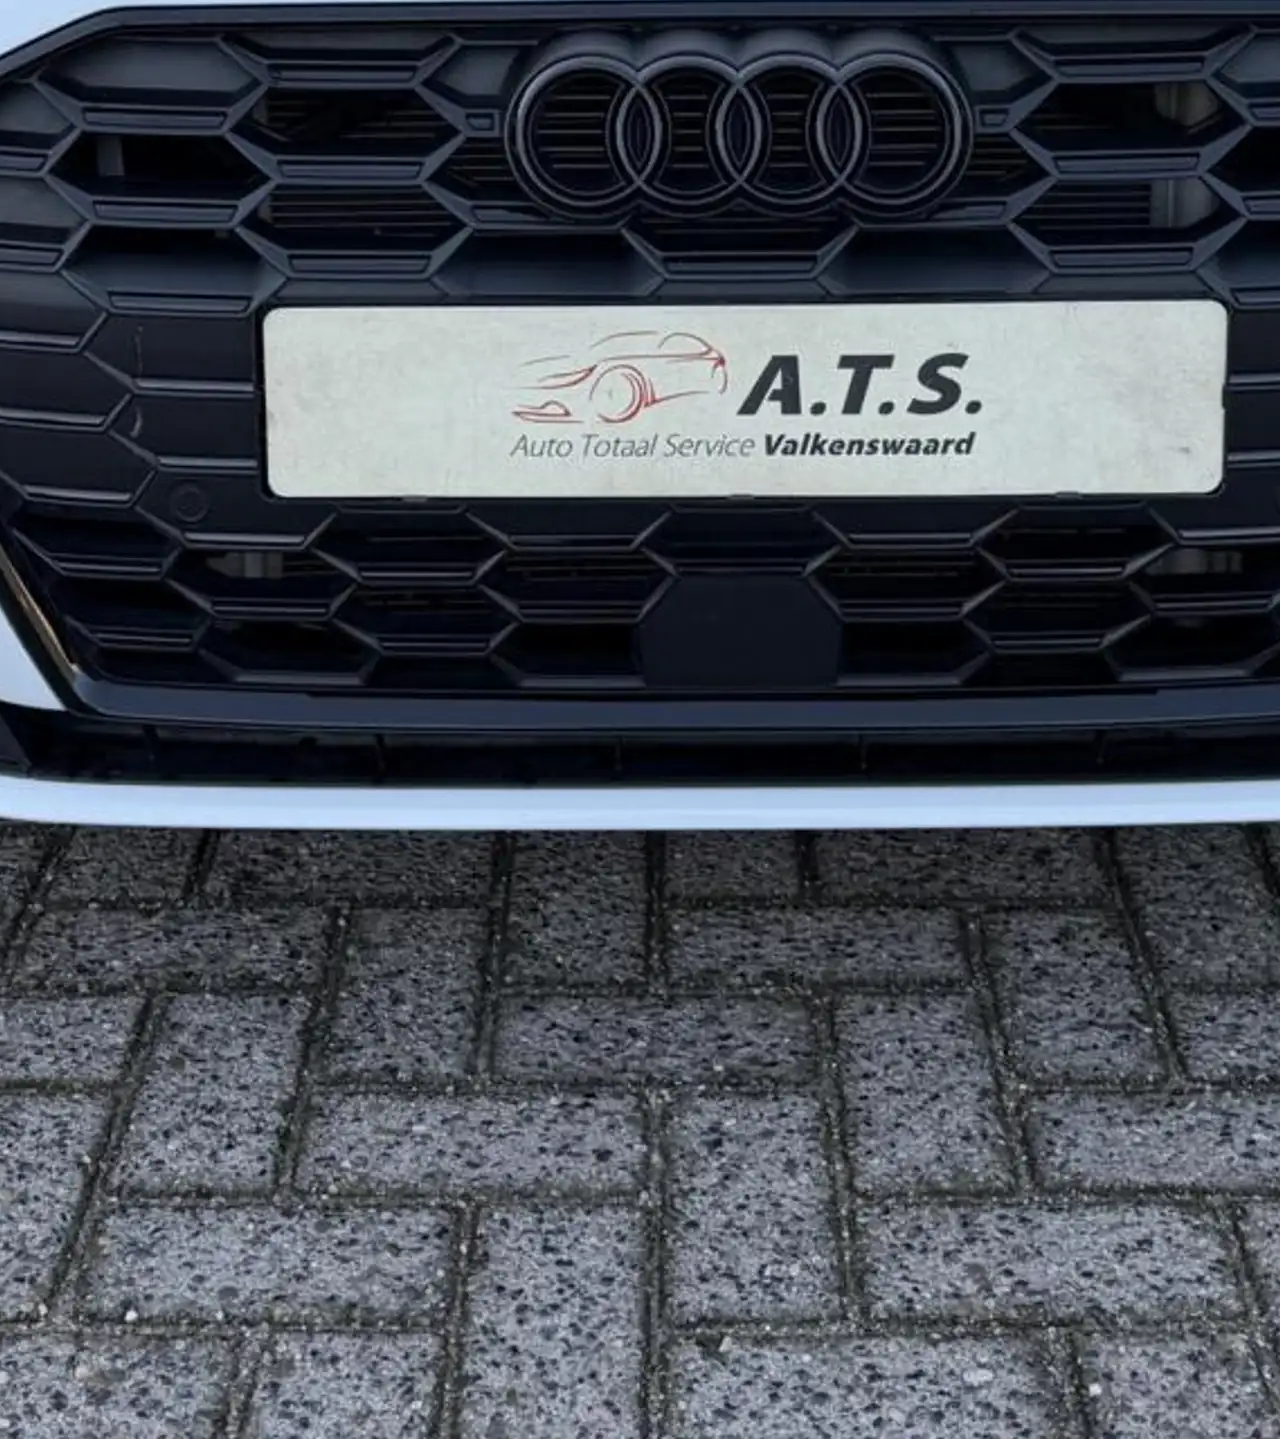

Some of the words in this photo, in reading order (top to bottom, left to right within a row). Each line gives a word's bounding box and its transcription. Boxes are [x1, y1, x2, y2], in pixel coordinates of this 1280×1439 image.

[737, 353, 983, 417] A.T.S.
[509, 433, 573, 458] Auto
[581, 433, 658, 458] Totaal
[664, 433, 756, 458] Service
[765, 431, 977, 457] Valkenswaard
